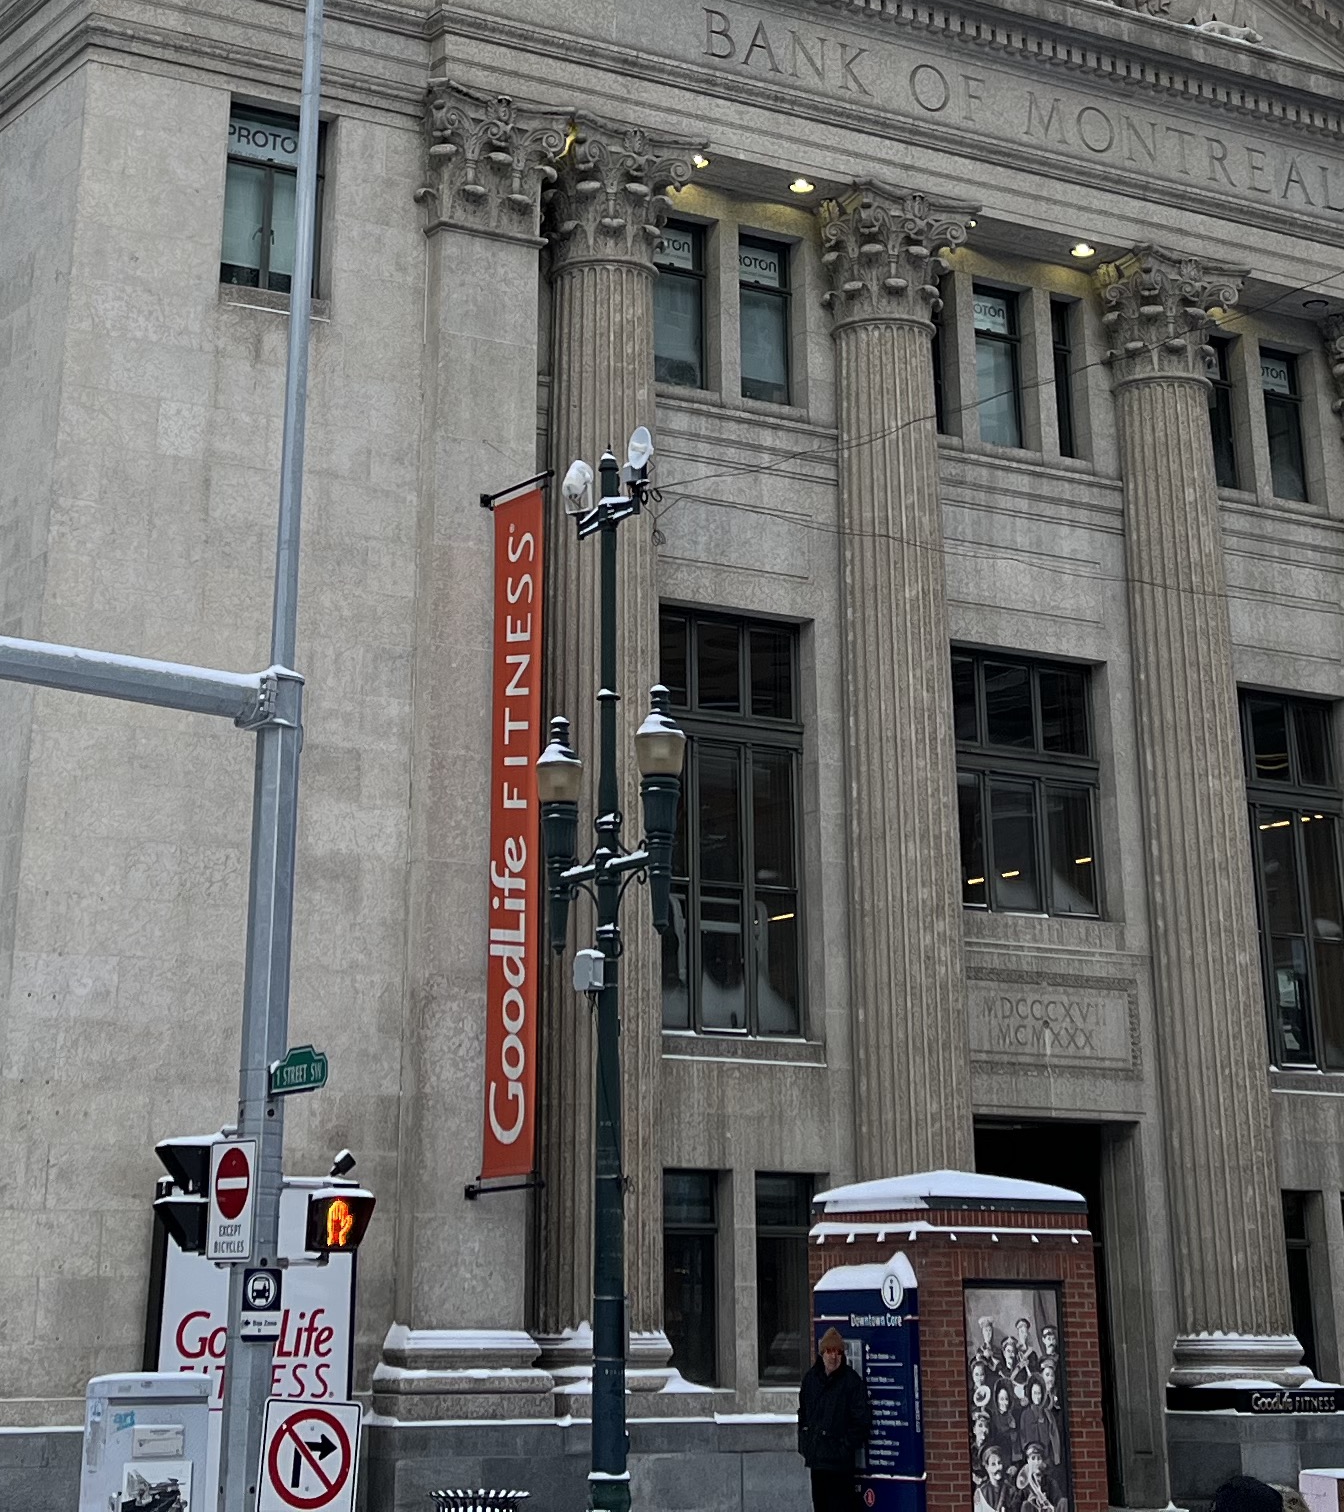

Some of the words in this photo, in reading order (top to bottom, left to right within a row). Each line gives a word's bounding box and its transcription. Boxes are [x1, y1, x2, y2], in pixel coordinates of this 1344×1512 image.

[701, 5, 875, 98] BANK
[908, 63, 986, 123] OF
[227, 123, 298, 155] PROTO
[502, 528, 535, 811] FITNESS
[488, 835, 528, 1147] GoodLife
[997, 1022, 1098, 1051] MCMXXX
[283, 1064, 308, 1086] STREET
[310, 1061, 323, 1082] SW
[218, 1223, 242, 1238] EXCEPT
[213, 1239, 245, 1254] BICYCLES
[175, 1308, 334, 1360] GoLife
[850, 1313, 886, 1328] Downtown
[886, 1312, 903, 1327] Core
[179, 1363, 332, 1399] TESS
[1251, 1391, 1293, 1411] GoodLife
[1295, 1396, 1336, 1411] FITNESS
